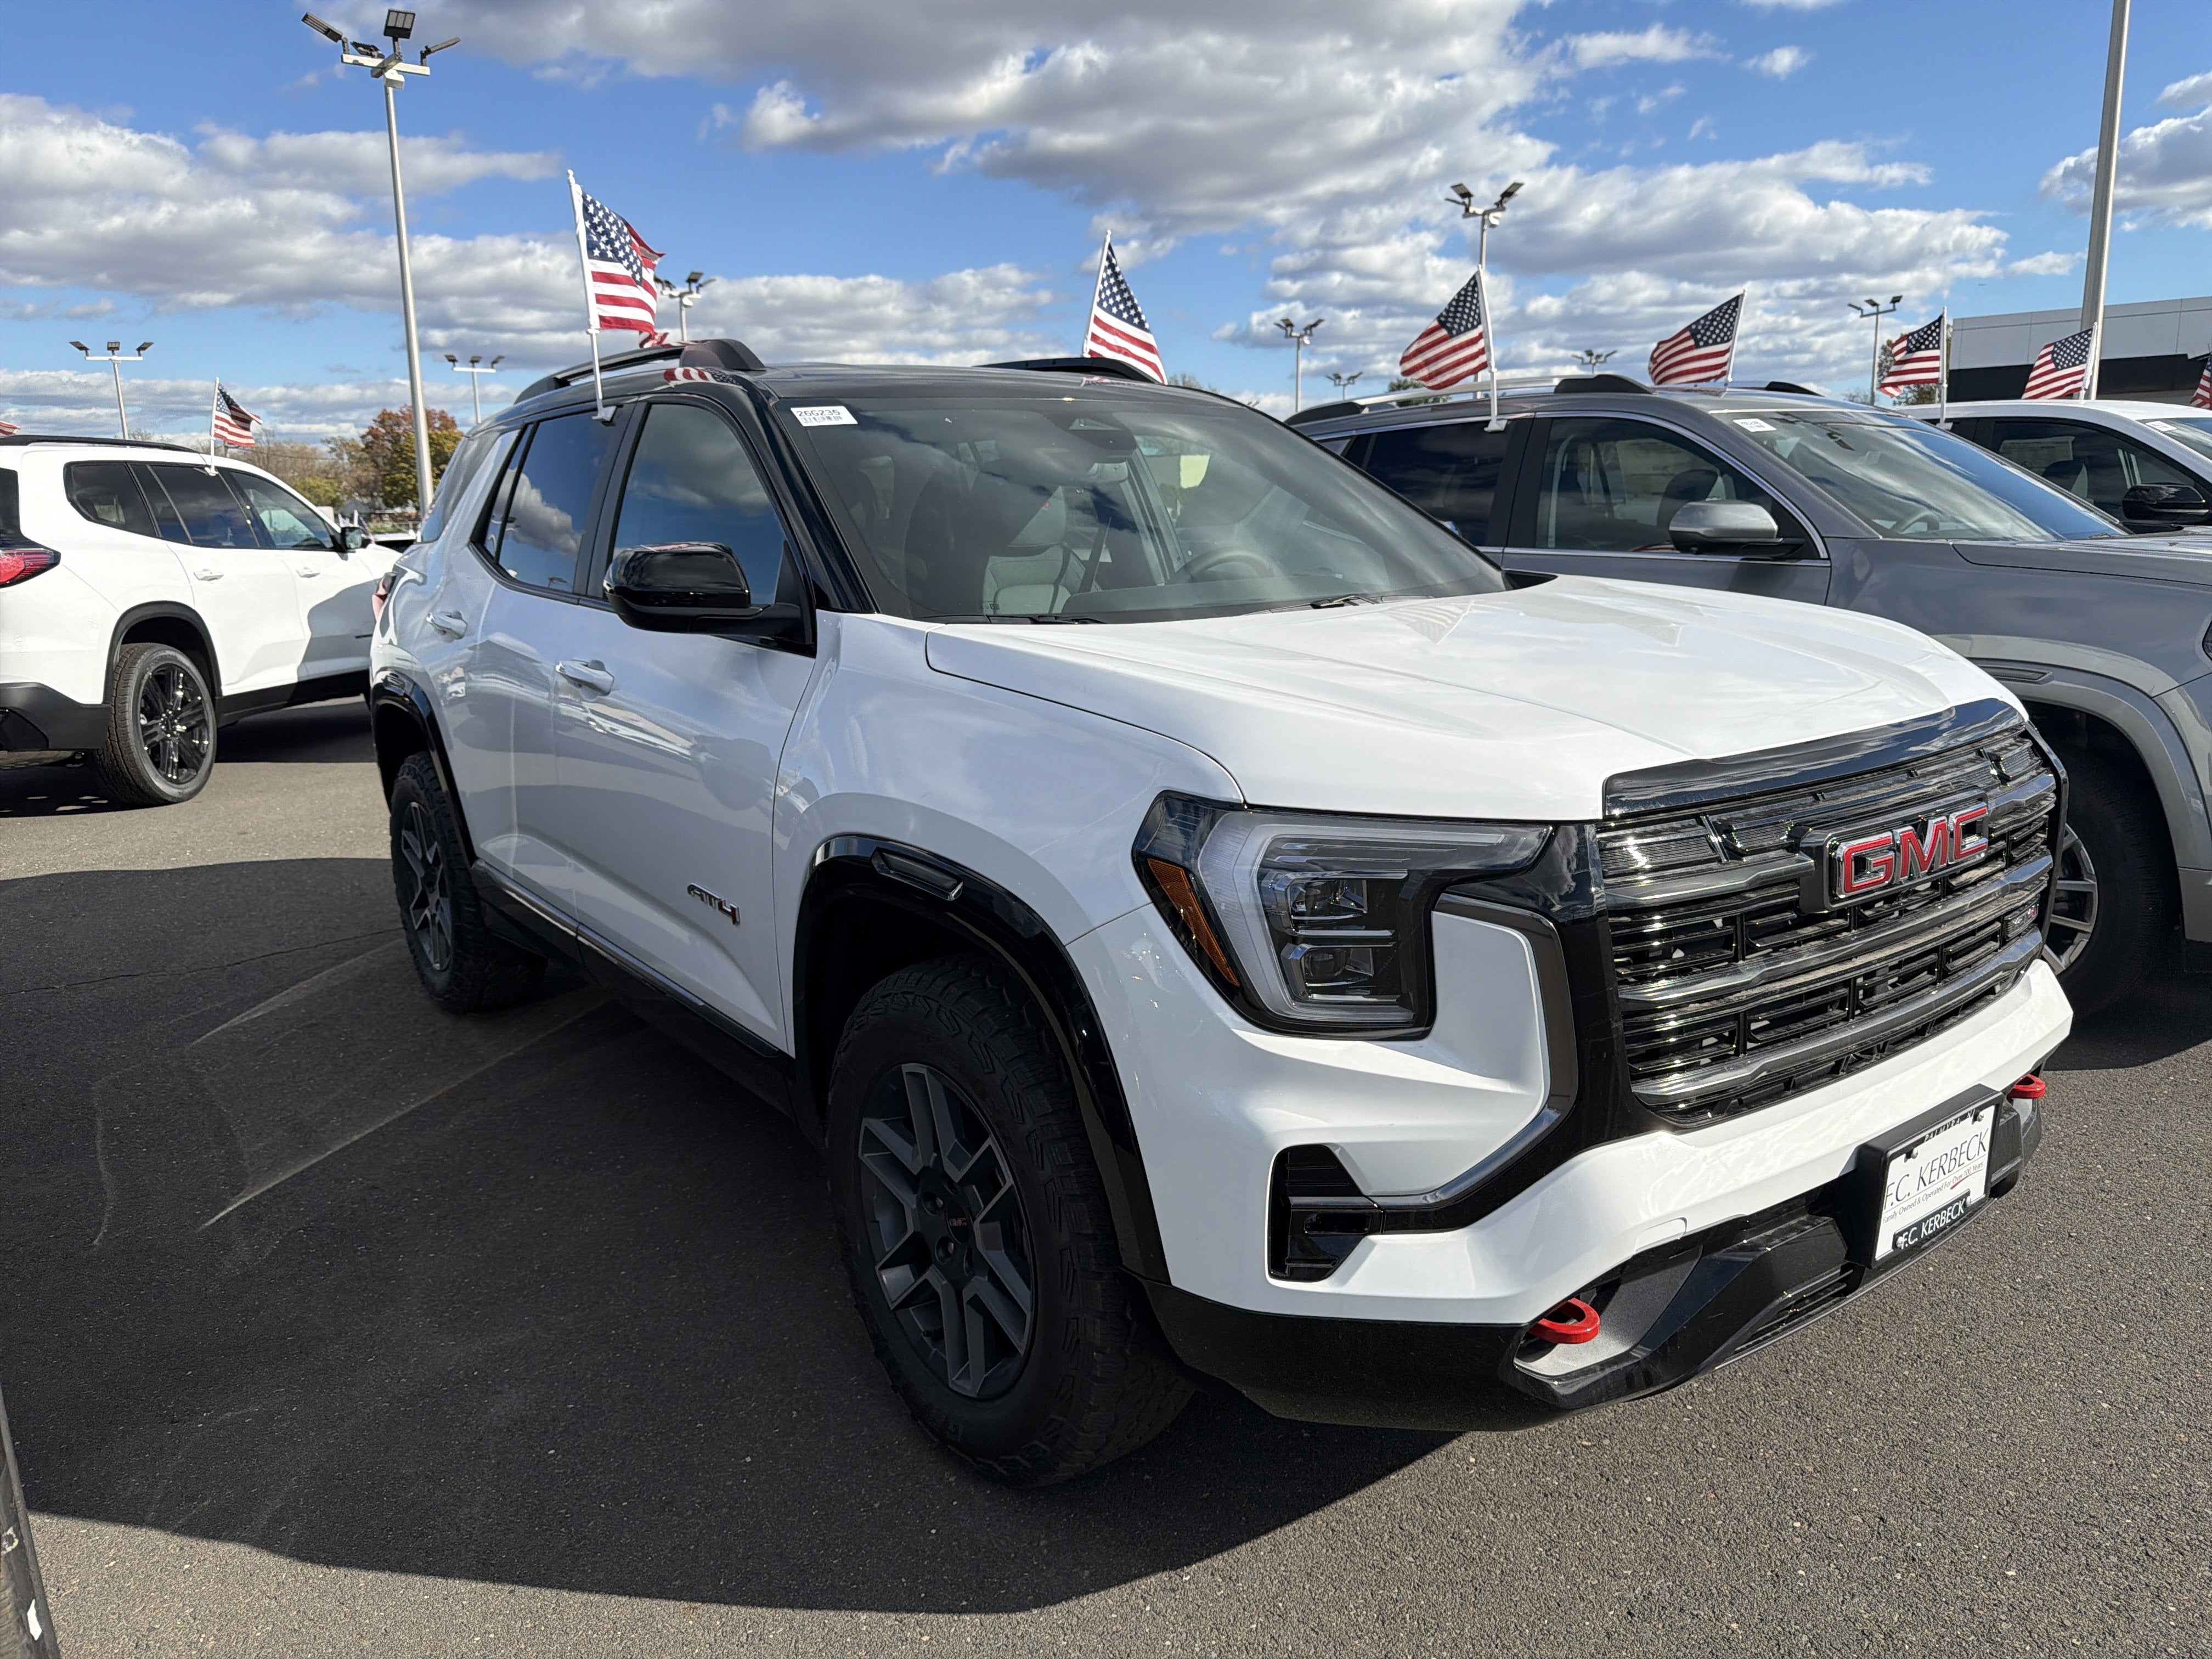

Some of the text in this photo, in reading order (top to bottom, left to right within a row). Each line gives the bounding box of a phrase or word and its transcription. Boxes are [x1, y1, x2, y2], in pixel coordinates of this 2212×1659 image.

[1836, 802, 1989, 899] GMC
[1883, 1210, 1898, 1224] Family
[1899, 1198, 1917, 1215] Owned
[1922, 1183, 1944, 1201] Operated
[1952, 1173, 1962, 1184] Over
[1973, 1161, 1984, 1172] Years
[1884, 1128, 1989, 1210] F.C. KERBECK
[1901, 1198, 1966, 1250] F.C. KERBECK
